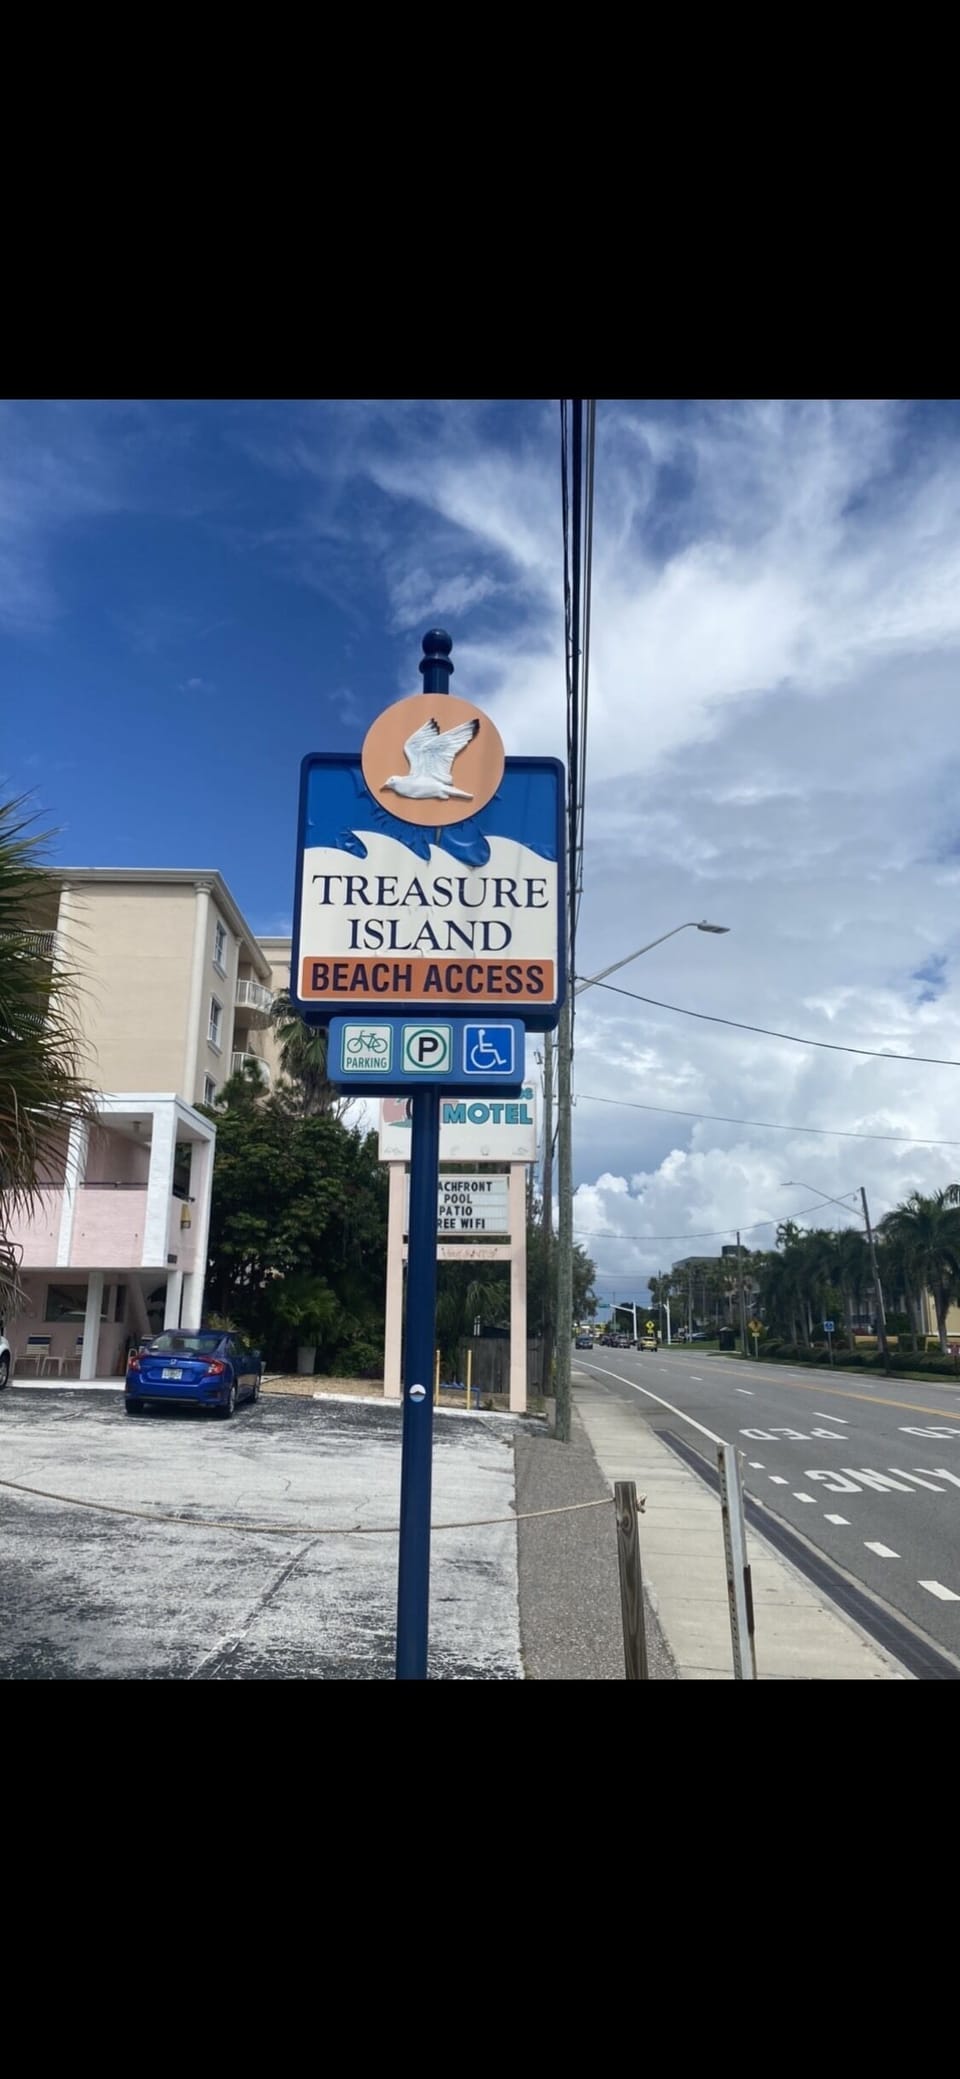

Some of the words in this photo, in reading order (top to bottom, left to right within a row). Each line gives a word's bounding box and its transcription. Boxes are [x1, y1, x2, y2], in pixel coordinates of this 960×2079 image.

[312, 874, 549, 909] TREASURE
[348, 918, 512, 952] ISLAND
[311, 963, 412, 992] BEACH
[423, 963, 544, 994] ACCESS
[418, 1036, 438, 1062] P
[346, 1057, 387, 1069] PARKING
[442, 1102, 533, 1125] MOTEL
[438, 1181, 493, 1192] ACHFRONT
[444, 1193, 473, 1204] POOL
[439, 1206, 473, 1216] PATIO
[437, 1218, 456, 1229] REE
[739, 1427, 849, 1440] PED
